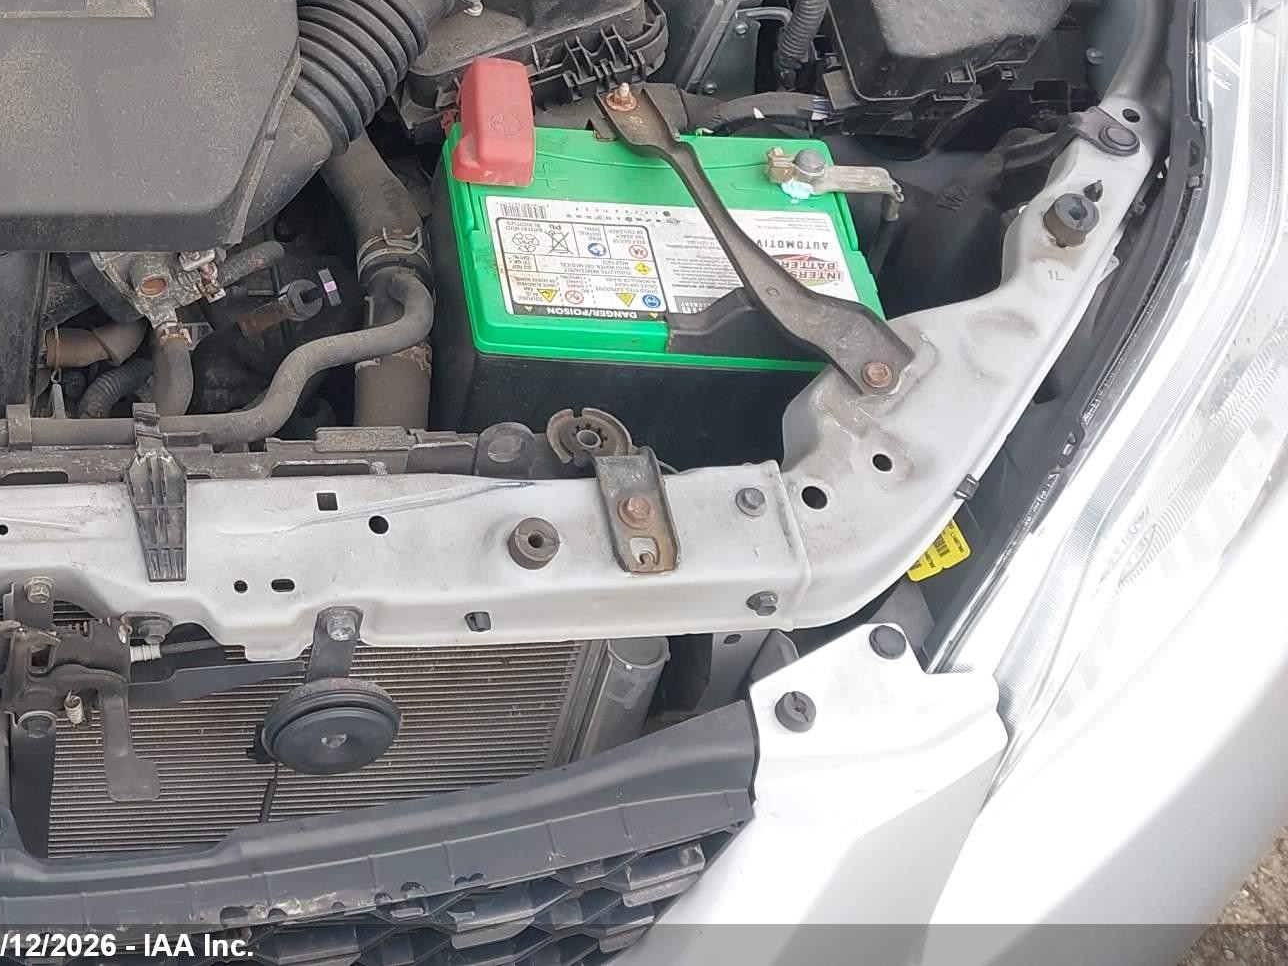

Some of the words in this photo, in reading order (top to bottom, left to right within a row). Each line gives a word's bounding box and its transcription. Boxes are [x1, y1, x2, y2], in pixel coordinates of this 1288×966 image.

[757, 239, 829, 250] AUTOMOTIV
[782, 261, 835, 270] BATTER
[791, 270, 841, 280] INTERS
[547, 307, 637, 319] DANGER/POISON
